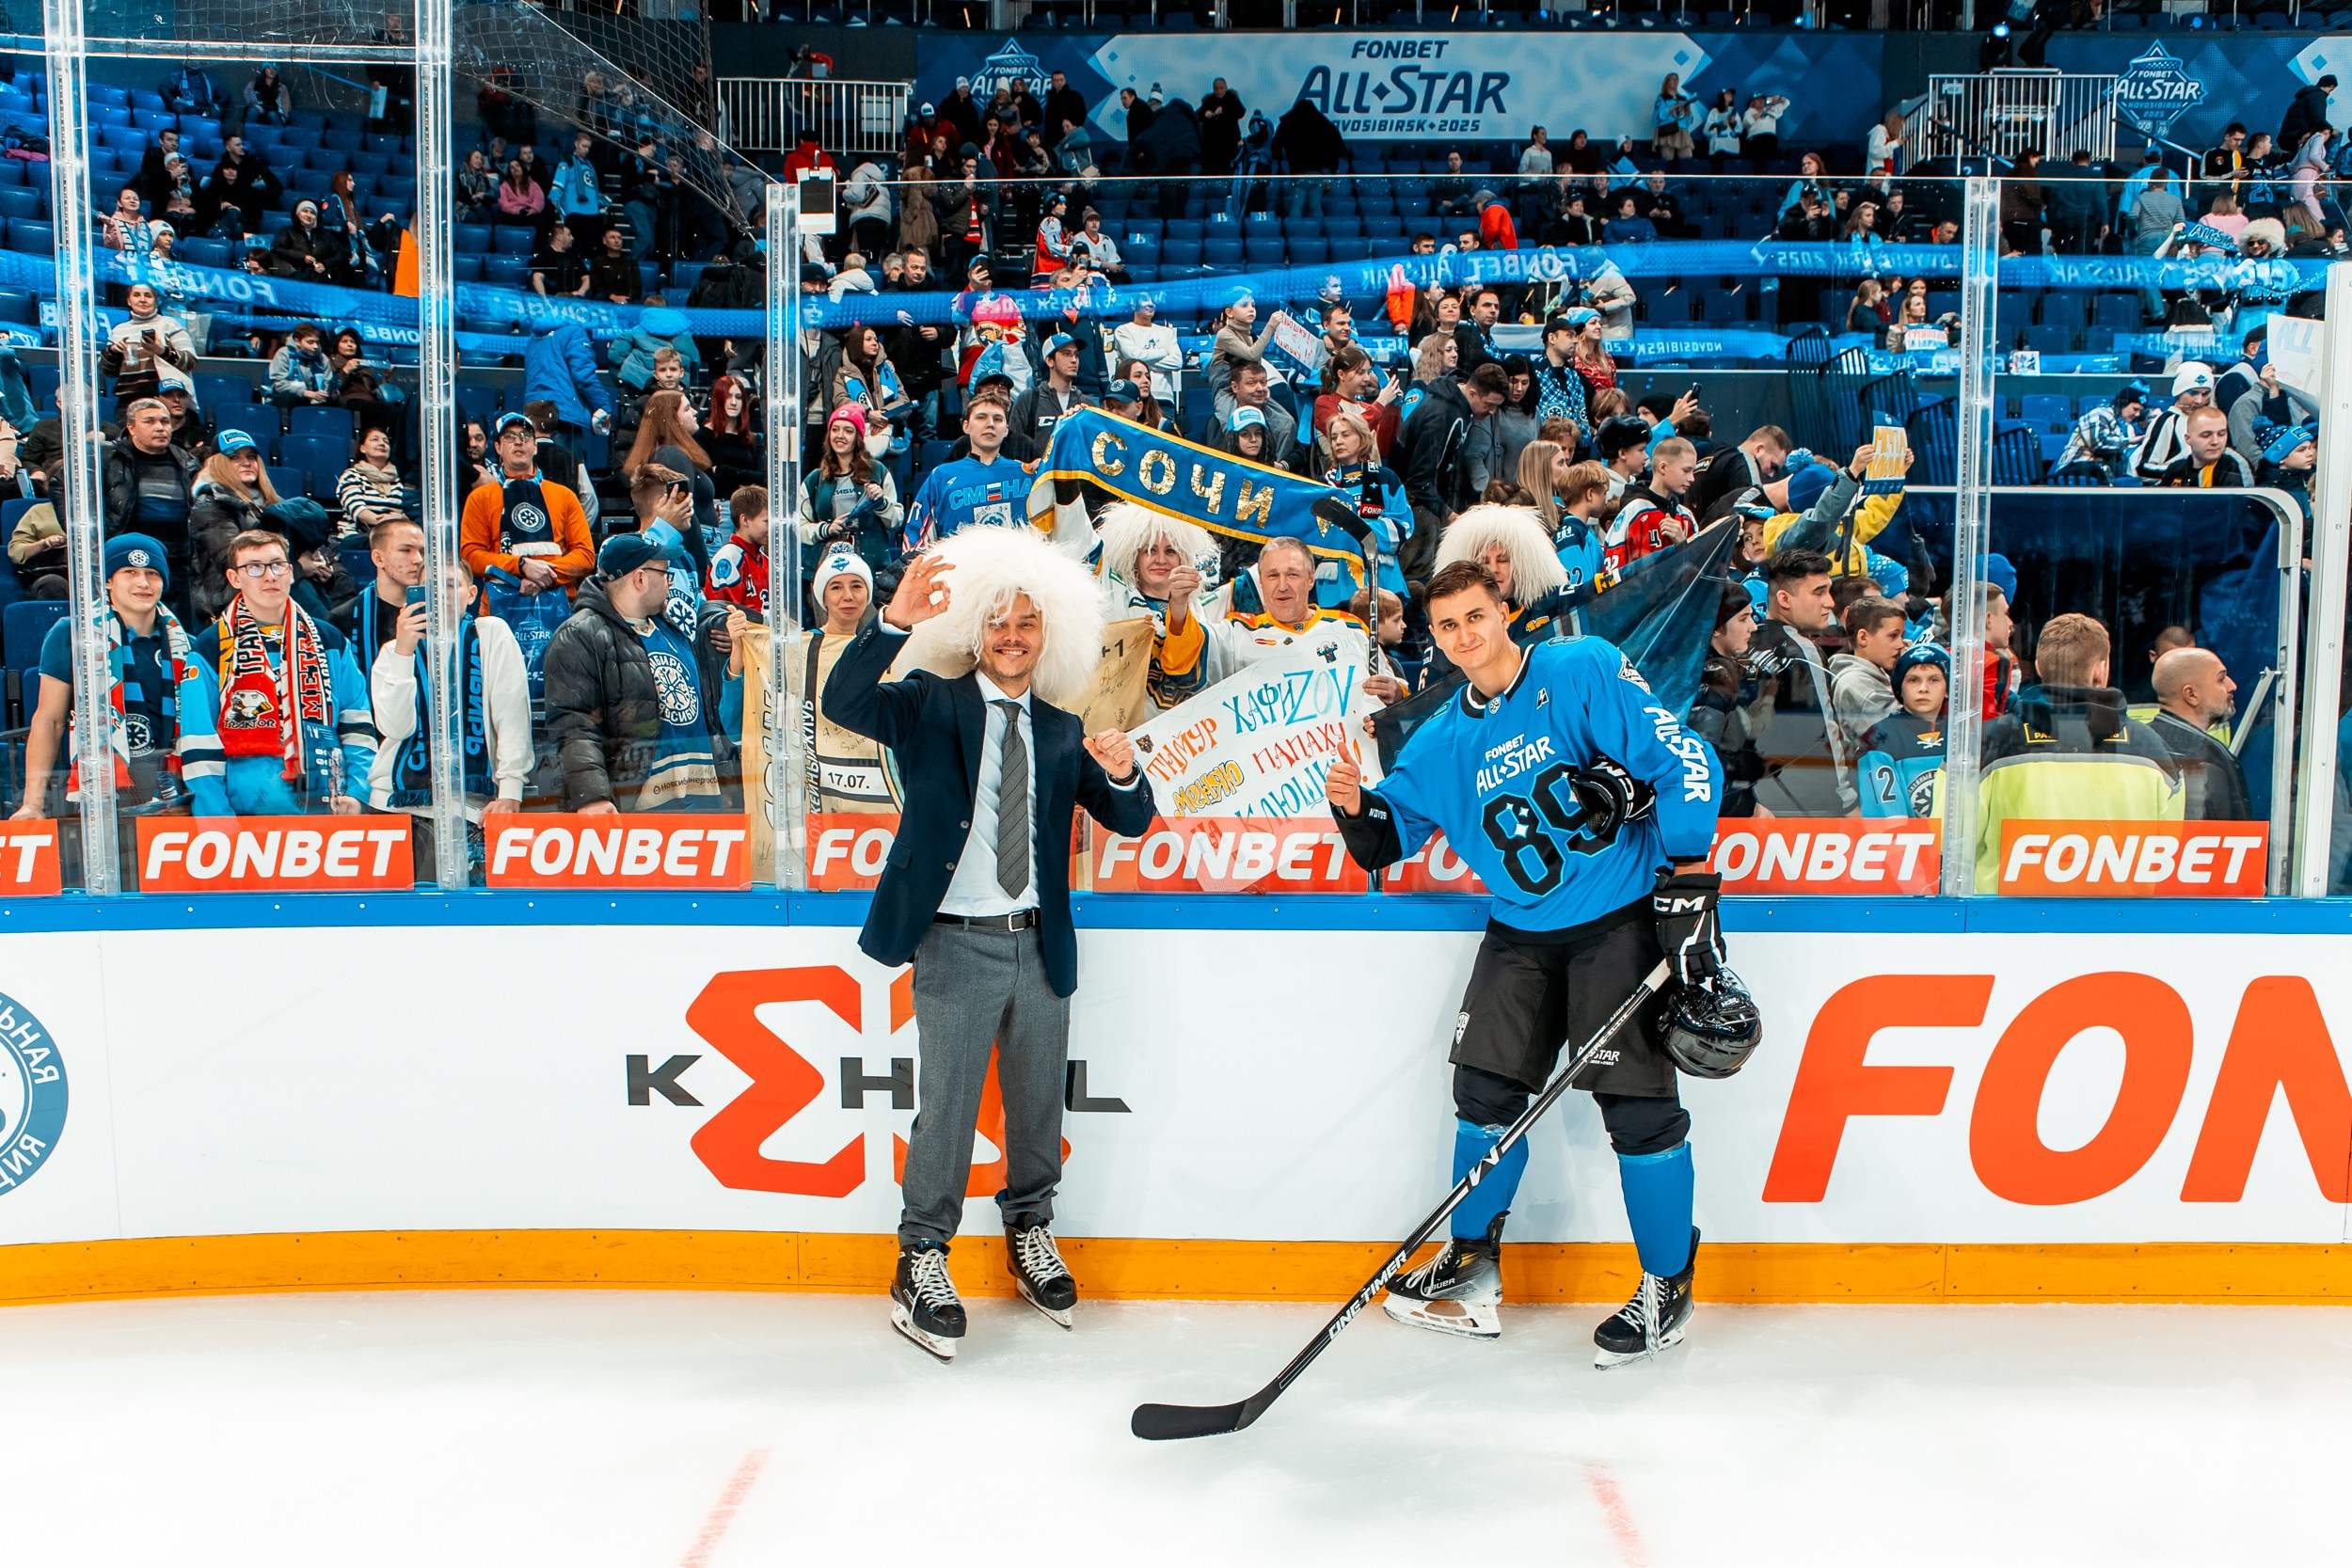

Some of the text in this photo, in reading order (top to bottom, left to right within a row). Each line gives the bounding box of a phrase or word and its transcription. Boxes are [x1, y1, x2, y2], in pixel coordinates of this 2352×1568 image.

[993, 67, 1029, 75] FONBET
[1351, 40, 1450, 59] FONBET
[1294, 64, 1511, 114] ALL STAR
[2116, 79, 2201, 100] ALL STAR
[1332, 119, 1481, 132] OVOSIBIRSK 2025
[1091, 431, 1275, 530] СОЧИ
[1361, 506, 1384, 515] FONB
[223, 719, 277, 730] TRAKTOR
[1252, 721, 1347, 775] ПАПАХУ
[1485, 734, 1525, 763] FONBET
[1146, 718, 1218, 783] ТИМУР
[1476, 736, 1556, 798] ALL STAR
[1667, 736, 1711, 803] STAR
[828, 771, 870, 789] 17.07.
[491, 828, 747, 878] FONBET
[1481, 760, 1622, 898] 89
[145, 830, 407, 879] FONBET
[1098, 832, 1347, 881] FONBET
[1707, 832, 1936, 881] ONBET
[2004, 834, 2263, 883] FONBET
[0, 999, 60, 1085] ЬНАЯ
[1761, 971, 2352, 1206] FON
[1328, 1249, 1409, 1341] ONE TIMER
